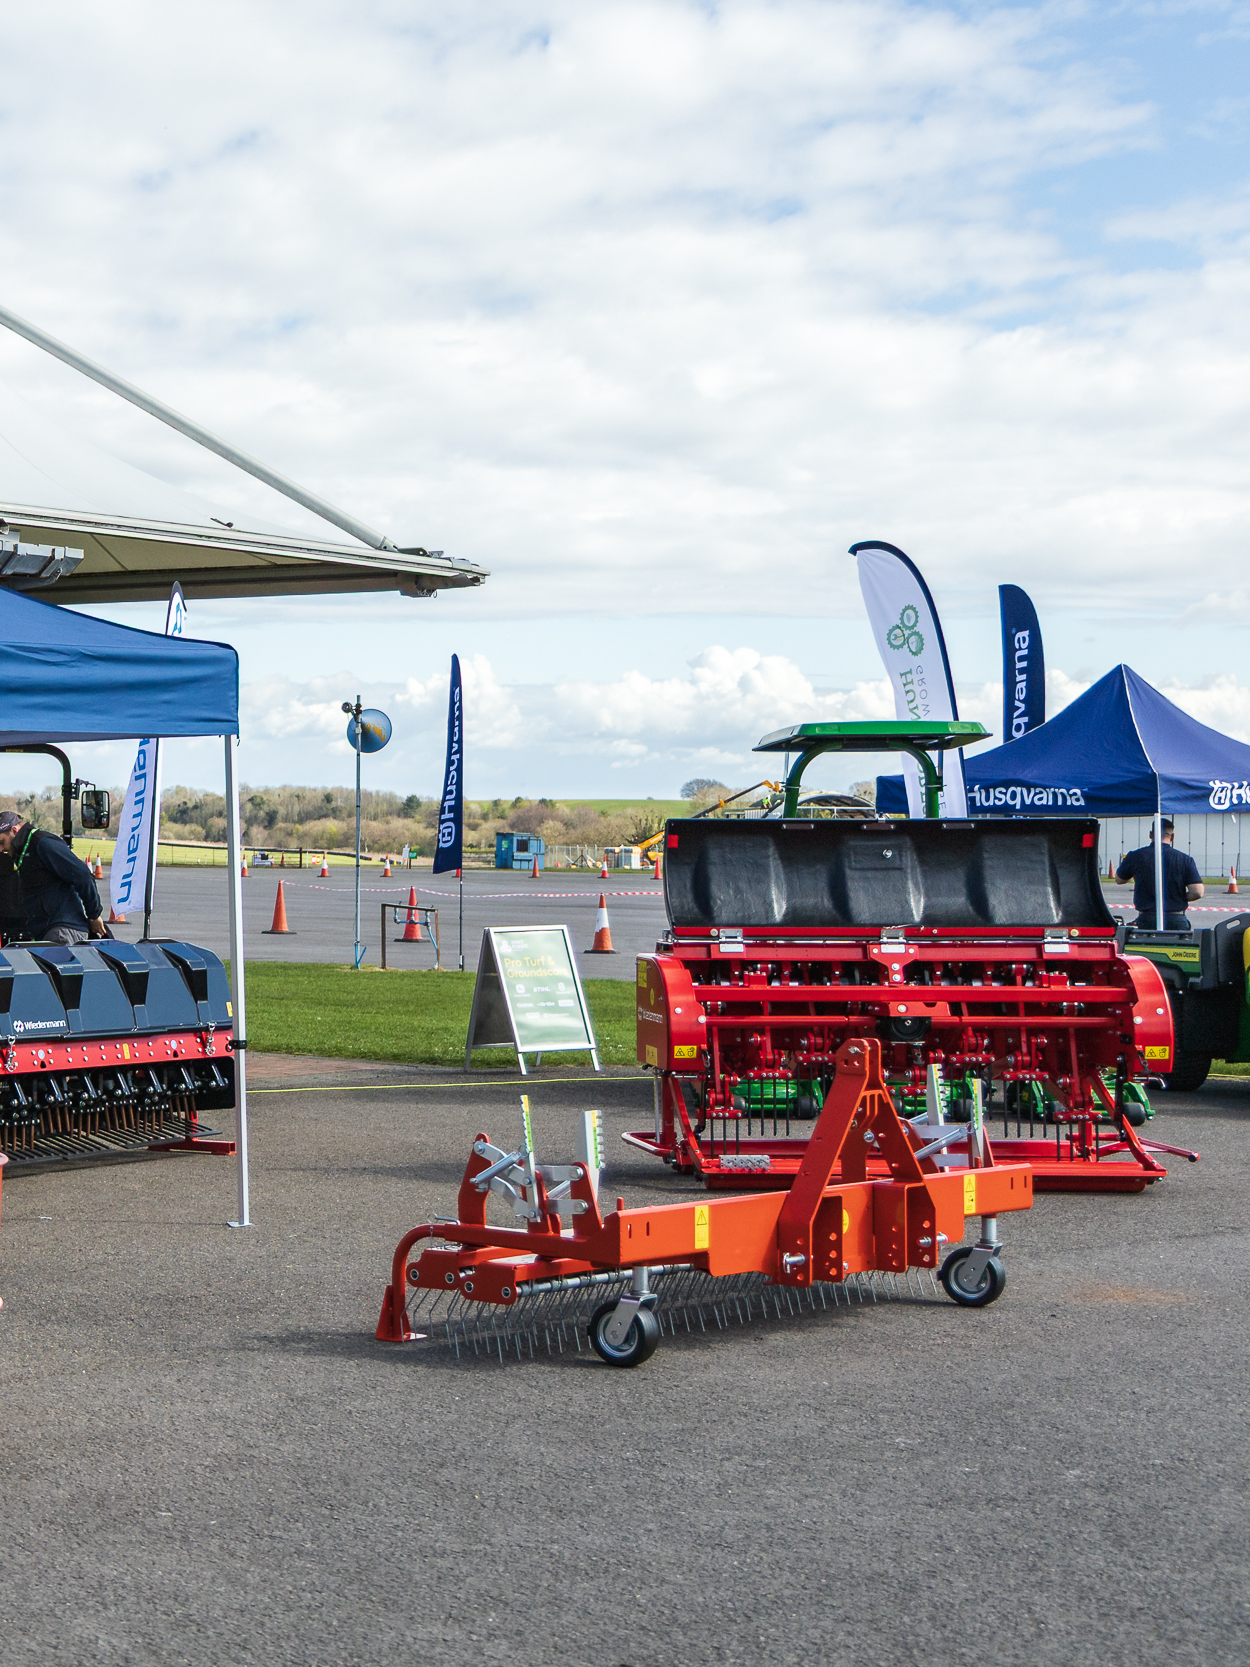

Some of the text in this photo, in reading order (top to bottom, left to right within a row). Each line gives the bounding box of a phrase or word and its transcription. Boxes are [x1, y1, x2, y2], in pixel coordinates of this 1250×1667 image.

[1012, 629, 1030, 738] qvarna
[967, 784, 1086, 810] Husqvarna
[116, 738, 150, 905] enmann
[1171, 950, 1197, 959] JOHN DEERE
[504, 955, 555, 968] Pro Turf &
[506, 967, 569, 978] Groundscare
[24, 1019, 67, 1031] Wiedenmann
